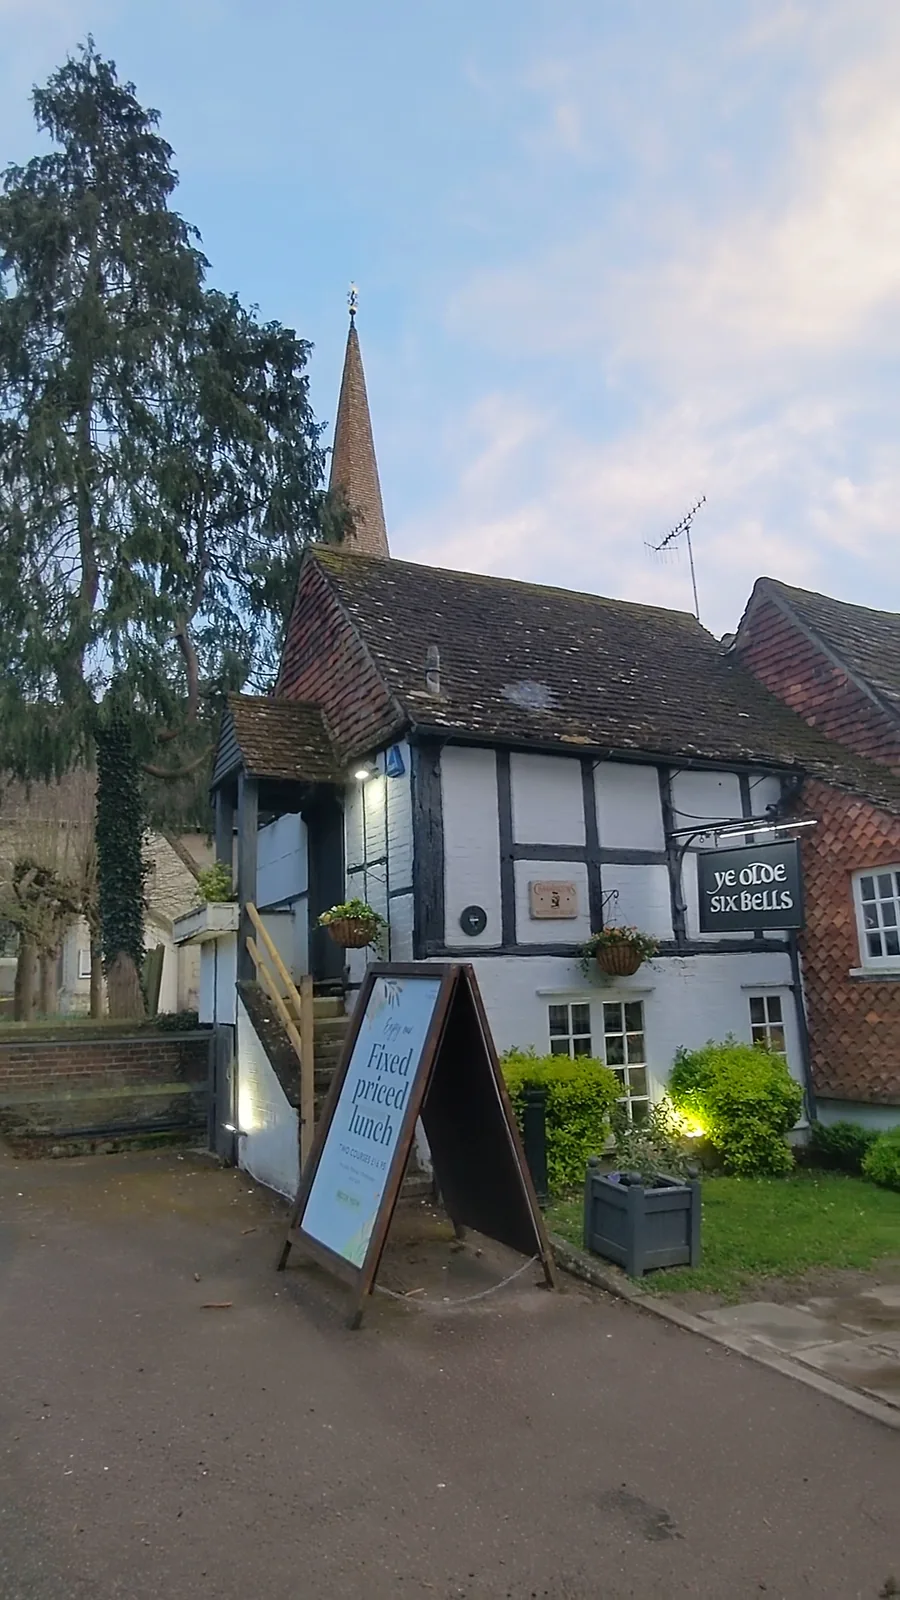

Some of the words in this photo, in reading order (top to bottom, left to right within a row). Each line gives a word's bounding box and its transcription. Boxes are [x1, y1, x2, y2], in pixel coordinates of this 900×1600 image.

[739, 862, 787, 885] OLDE
[710, 895, 739, 912] SIX
[741, 890, 793, 910] BELLS
[367, 1043, 413, 1077] Fixed
[352, 1075, 409, 1110] priced
[348, 1105, 393, 1146] lunch
